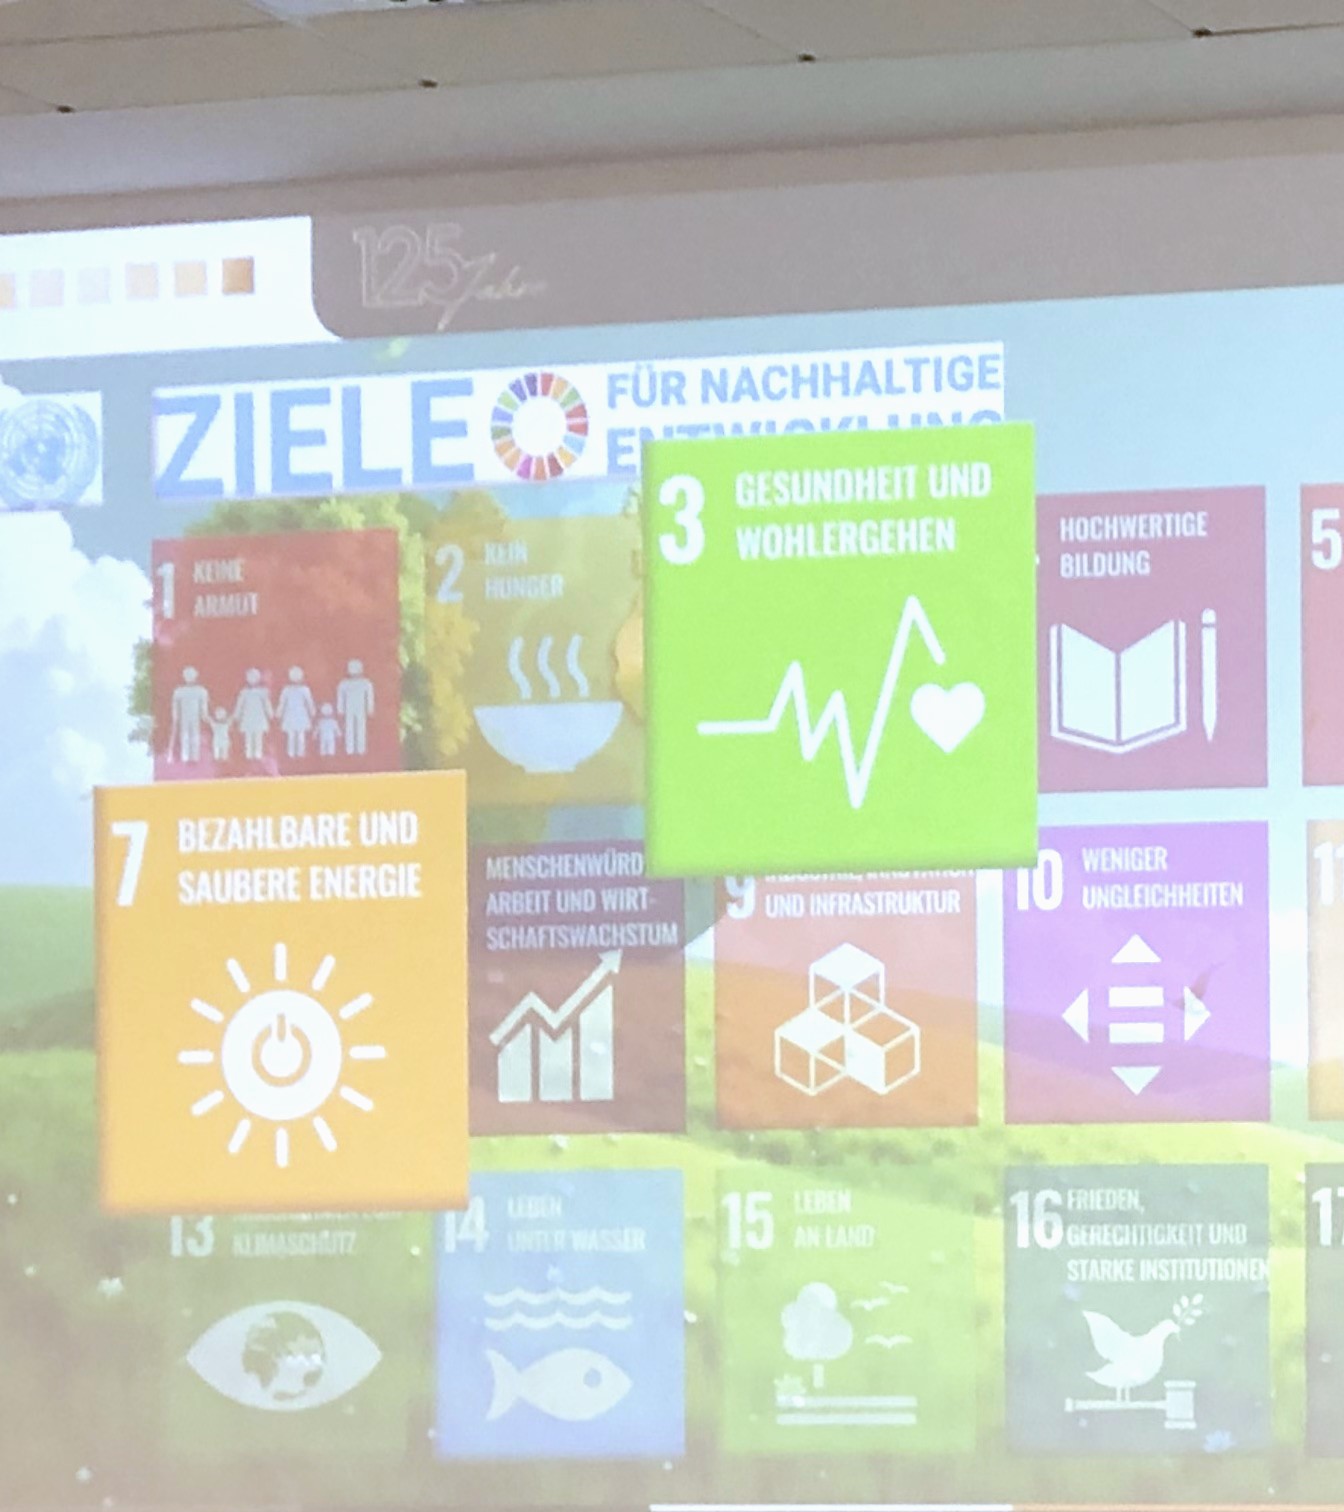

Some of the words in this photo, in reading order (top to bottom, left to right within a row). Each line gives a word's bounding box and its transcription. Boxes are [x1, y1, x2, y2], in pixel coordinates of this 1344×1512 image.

[353, 222, 463, 308] 125
[607, 364, 687, 409] FÜR
[701, 354, 1000, 405] NACHHALTIGE
[156, 378, 474, 496] ZIELE
[735, 465, 916, 507] GESUNDHEIT
[928, 462, 991, 498] UND
[659, 474, 705, 565] 3
[735, 518, 955, 560] WOHLERGEHEN
[1059, 511, 1207, 543] HOCHWERTIGE
[1311, 508, 1342, 570] 5
[193, 559, 245, 584] KEINE
[484, 540, 528, 565] KEIN
[1059, 551, 1150, 579] BILDUNG
[156, 563, 175, 619] 1
[434, 543, 464, 606] 2
[484, 574, 564, 599] HUNGER
[193, 592, 259, 617] ARMUT
[178, 812, 351, 853] BEZAHLBARE
[359, 811, 418, 846] UND
[111, 821, 148, 907] 7
[486, 848, 644, 880] MENSCHENWÜRD
[1015, 849, 1064, 911] 10
[1082, 846, 1168, 873] WENIGER
[178, 867, 301, 906] SAUBERE
[309, 863, 422, 899] ENERGIE
[486, 889, 551, 916] ARBEIT
[556, 888, 596, 912] UND
[765, 894, 804, 917] UND
[810, 889, 961, 916] INFRASTRUKTUR
[1082, 881, 1243, 909] UNGLEICHHEITEN
[486, 923, 678, 950] SCHAFTSWACHSTUM
[722, 1190, 774, 1249] 15
[1009, 1188, 1063, 1249] 16
[1067, 1188, 1144, 1214] FRIEDEN,
[445, 1196, 490, 1253] 14
[1067, 1222, 1202, 1247] GERECHTIGKEIT
[1208, 1222, 1247, 1245] UND
[1067, 1259, 1135, 1282] STARKE
